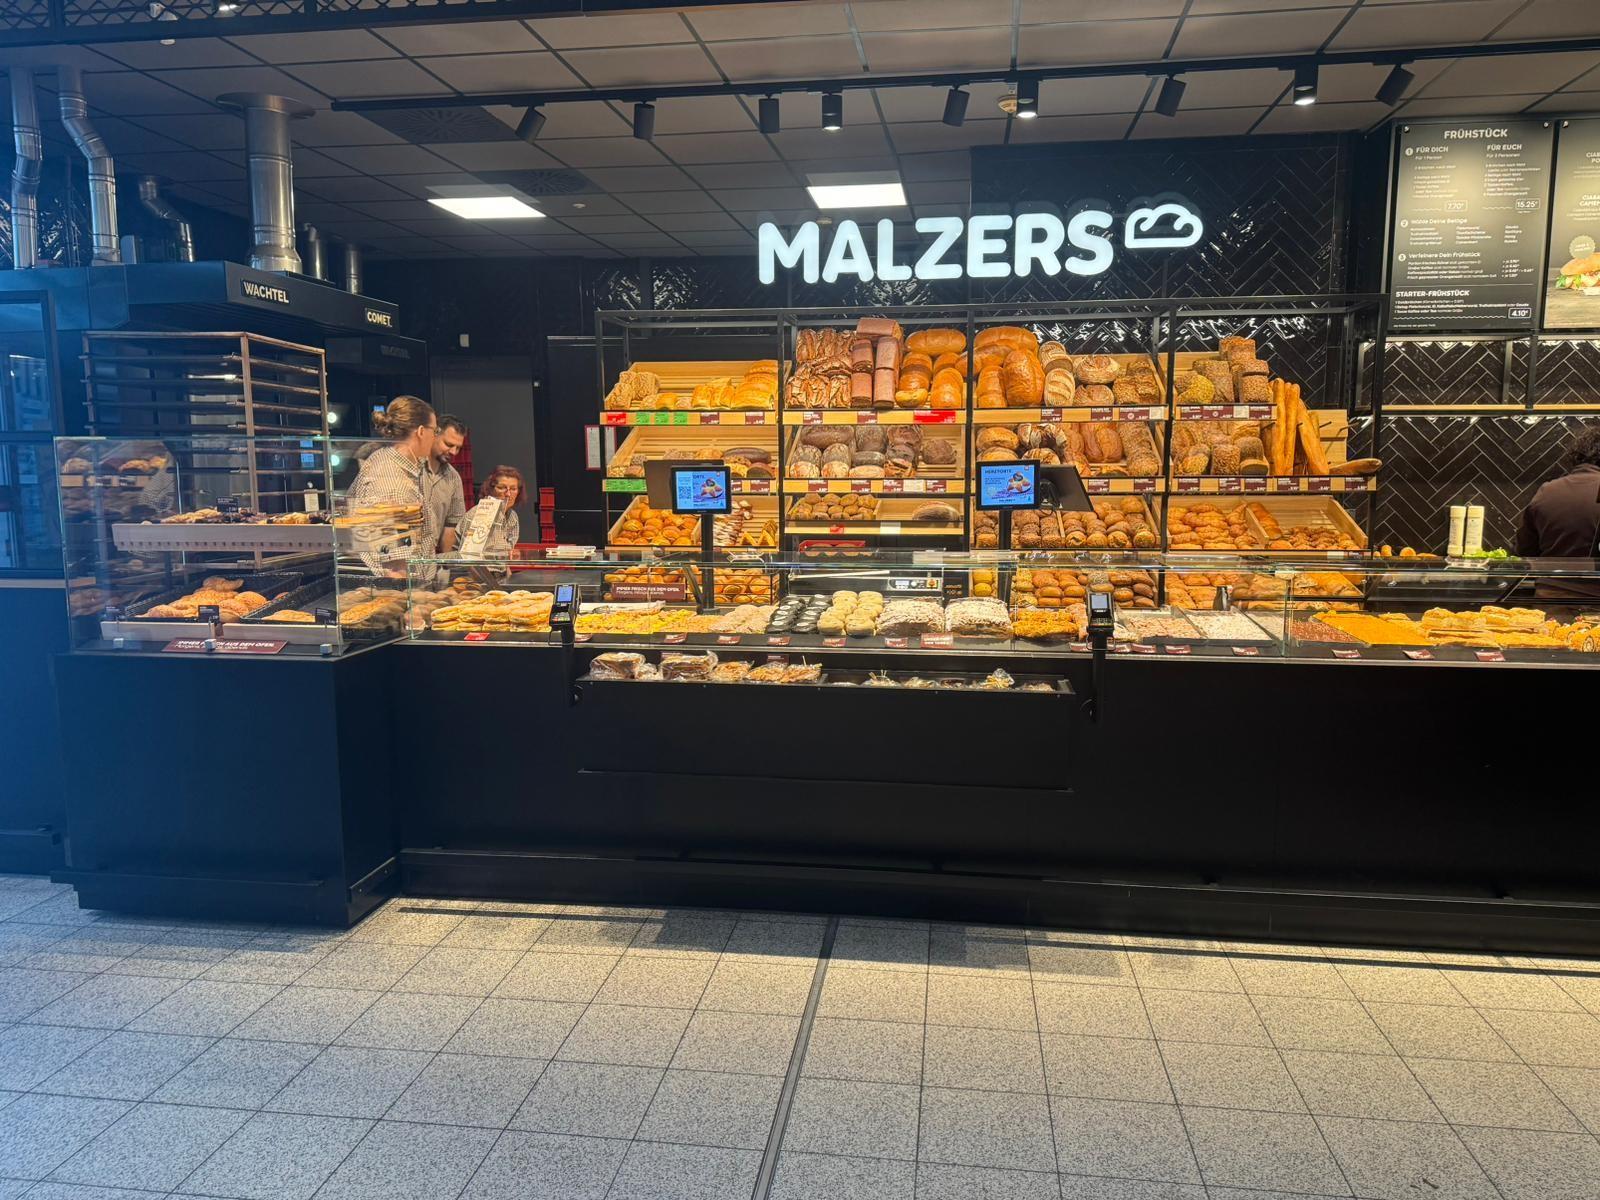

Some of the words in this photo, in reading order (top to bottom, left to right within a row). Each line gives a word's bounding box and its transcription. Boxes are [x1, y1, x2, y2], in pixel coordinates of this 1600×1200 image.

[1444, 128, 1508, 140] FRÜHSTÜCK
[1416, 146, 1430, 154] FÜR
[1502, 143, 1522, 151] EUCH
[758, 209, 1115, 285] MALZERS
[243, 281, 290, 304] WACHTEL
[1395, 289, 1470, 298] STARTER-FRÜHSTÜCK
